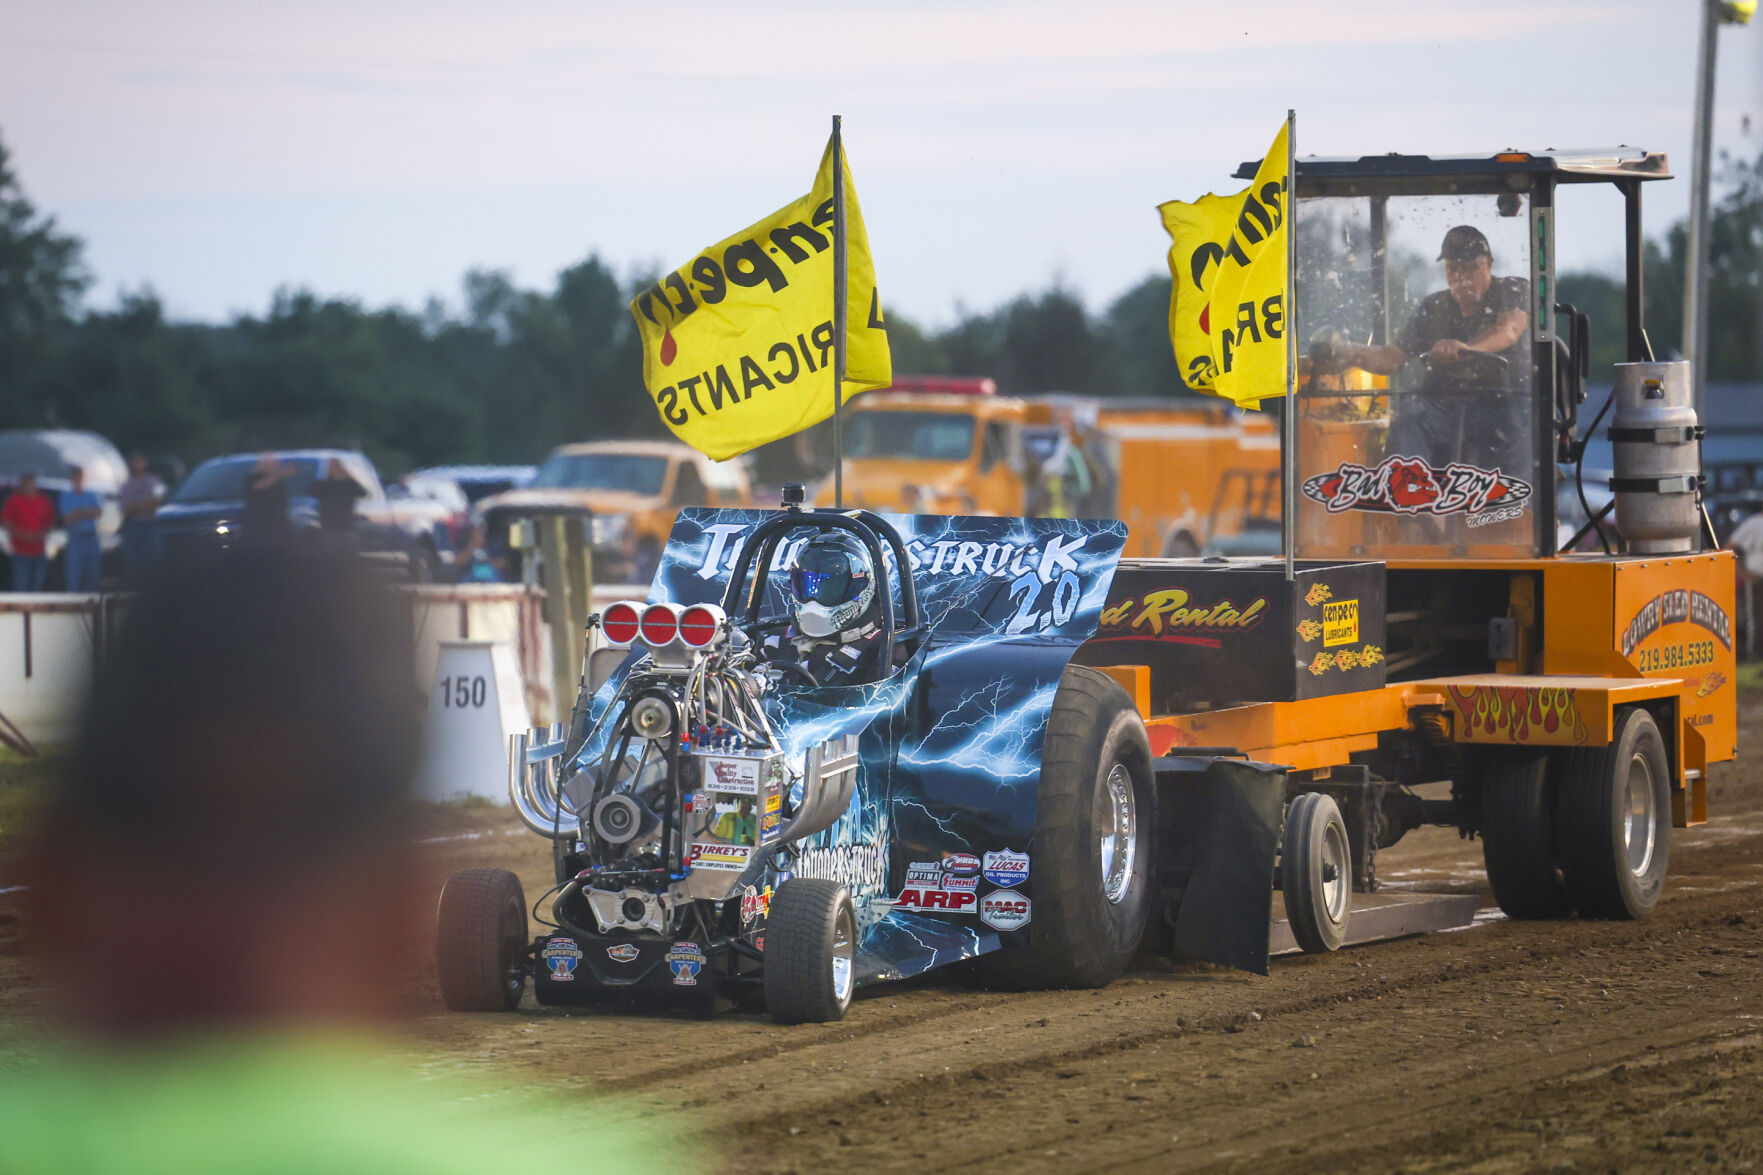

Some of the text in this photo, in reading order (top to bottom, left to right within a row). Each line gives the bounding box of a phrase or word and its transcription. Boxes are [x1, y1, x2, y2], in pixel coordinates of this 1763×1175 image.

[1005, 570, 1080, 634] 2.0
[1131, 588, 1266, 636] Rental
[1662, 588, 1689, 627] SLED
[1690, 589, 1731, 653] RENTAL
[1325, 627, 1352, 640] LUBRICANTS
[1639, 641, 1714, 672] 219.984.5333
[440, 675, 487, 708] 150
[690, 844, 749, 860] BIRKEY'S
[908, 871, 938, 881] OPTIMA
[988, 861, 1027, 871] LUCAS
[894, 889, 976, 909] ARP
[985, 901, 1028, 913] MAC
